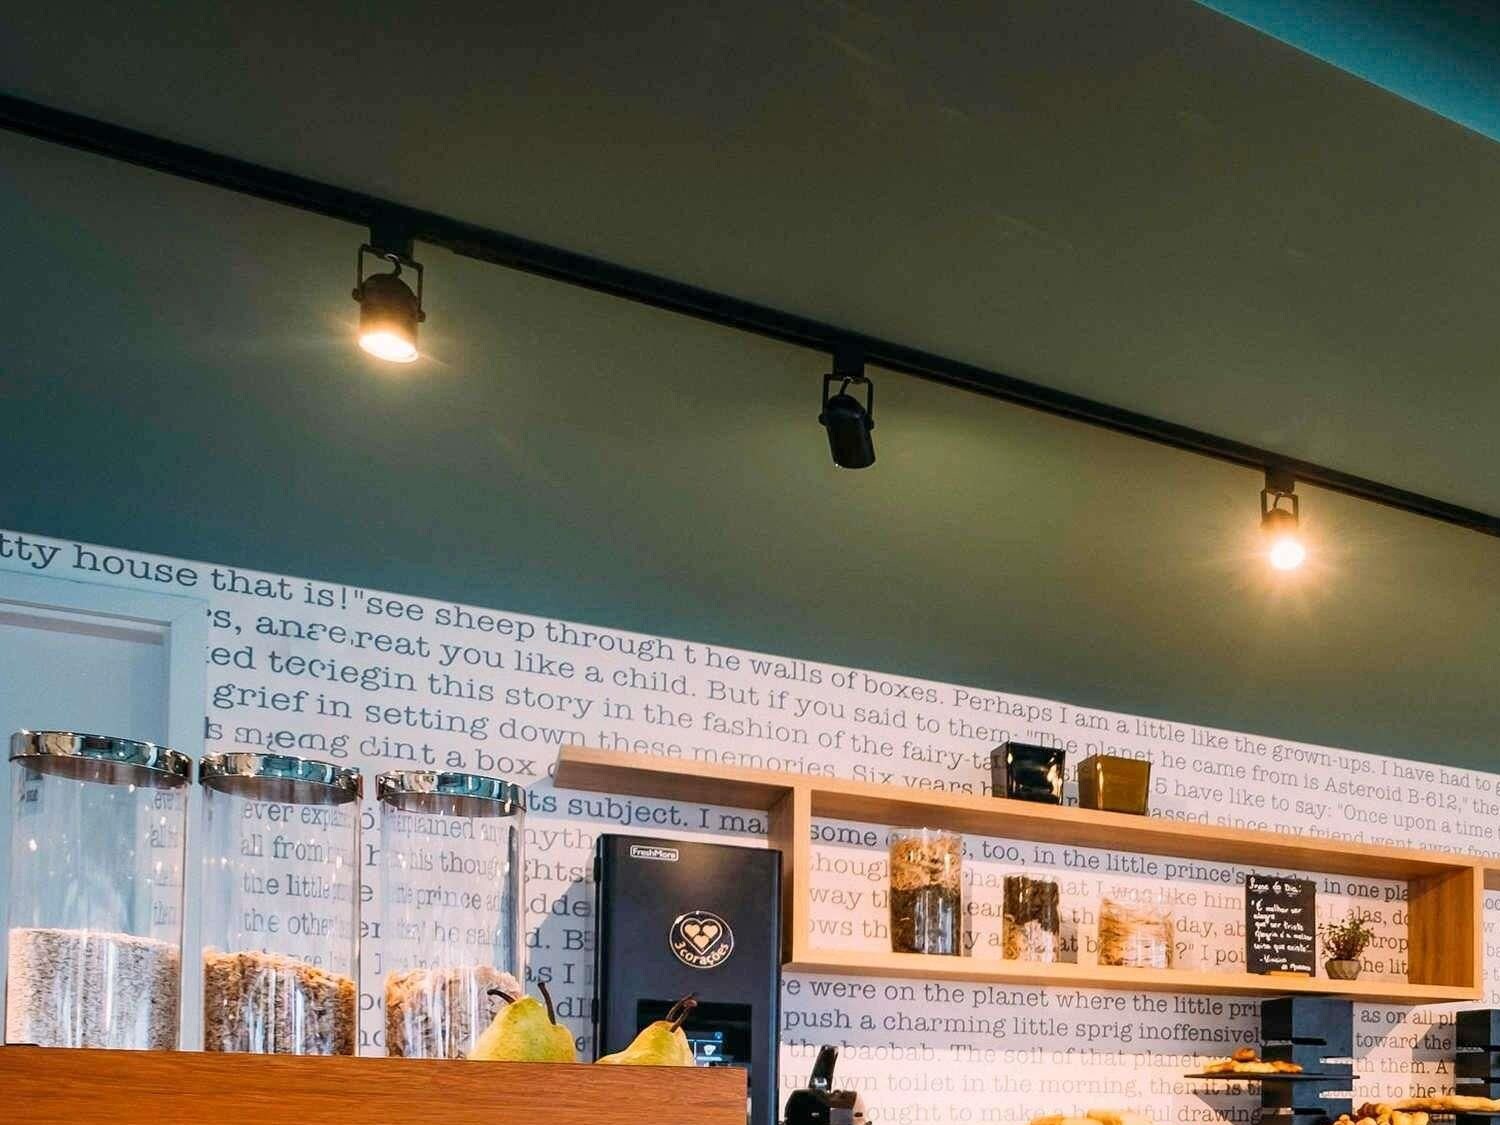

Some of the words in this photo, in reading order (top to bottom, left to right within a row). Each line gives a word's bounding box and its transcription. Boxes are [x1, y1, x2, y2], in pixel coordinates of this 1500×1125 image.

[72, 544, 198, 586] house
[210, 569, 293, 600] that
[435, 606, 535, 641] sheep
[545, 621, 673, 661] through
[748, 658, 823, 685] walls
[831, 667, 858, 688] of
[864, 673, 945, 704] boxes.
[952, 688, 1051, 722] Perhaps
[1059, 705, 1067, 724] I
[1075, 712, 1110, 731] am
[1116, 720, 1130, 734] a
[1135, 719, 1186, 743] little
[1192, 727, 1229, 750] like
[1235, 735, 1267, 757] the
[1272, 743, 1378, 775] grown-ups.
[1382, 760, 1390, 776] I
[1393, 761, 1435, 782] have
[1440, 769, 1470, 789] had
[1475, 777, 1491, 792] to
[212, 682, 309, 712] grief
[317, 695, 352, 719] in
[365, 702, 490, 741] setting
[499, 717, 586, 748] down
[439, 643, 505, 669] you
[514, 650, 575, 680] like
[584, 664, 604, 684] a
[612, 667, 697, 697] child.
[706, 679, 760, 706] But
[768, 690, 789, 710] if
[793, 698, 845, 718] you
[853, 708, 907, 729] said
[916, 713, 941, 734] to
[1161, 751, 1187, 769] he
[1192, 760, 1247, 779] came
[1251, 765, 1299, 788] from
[1303, 774, 1321, 791] is
[1325, 776, 1401, 802] Asteroid
[427, 672, 494, 702] this
[505, 686, 594, 719] story
[603, 698, 633, 721] in
[643, 704, 694, 729] the
[702, 711, 809, 745] fashion
[818, 730, 846, 749] of
[852, 734, 894, 758] the
[1175, 780, 1223, 801] have
[1228, 786, 1265, 806] like
[1270, 796, 1290, 812] to
[1295, 802, 1333, 820] say:
[1392, 813, 1437, 835] upon
[1441, 820, 1453, 834] a
[1455, 820, 1493, 839] time
[568, 797, 689, 828] subject.
[982, 841, 1026, 866] too,
[1034, 846, 1056, 865] in
[1062, 849, 1100, 871] the
[1105, 852, 1158, 877] little
[1165, 862, 1246, 884] prince's
[632, 847, 676, 860] FreshMore
[679, 943, 730, 966] corações
[783, 1008, 851, 1034] push
[859, 1014, 876, 1030] a
[883, 1011, 1007, 1039] charming
[1013, 1015, 1068, 1038] little
[1075, 1020, 1133, 1043] sprig
[808, 980, 876, 1000] were
[884, 984, 915, 1002] on
[923, 982, 965, 1004] the
[972, 985, 1050, 1012] planet
[1056, 991, 1126, 1012] where
[1132, 994, 1168, 1014] the
[1172, 996, 1223, 1016] little
